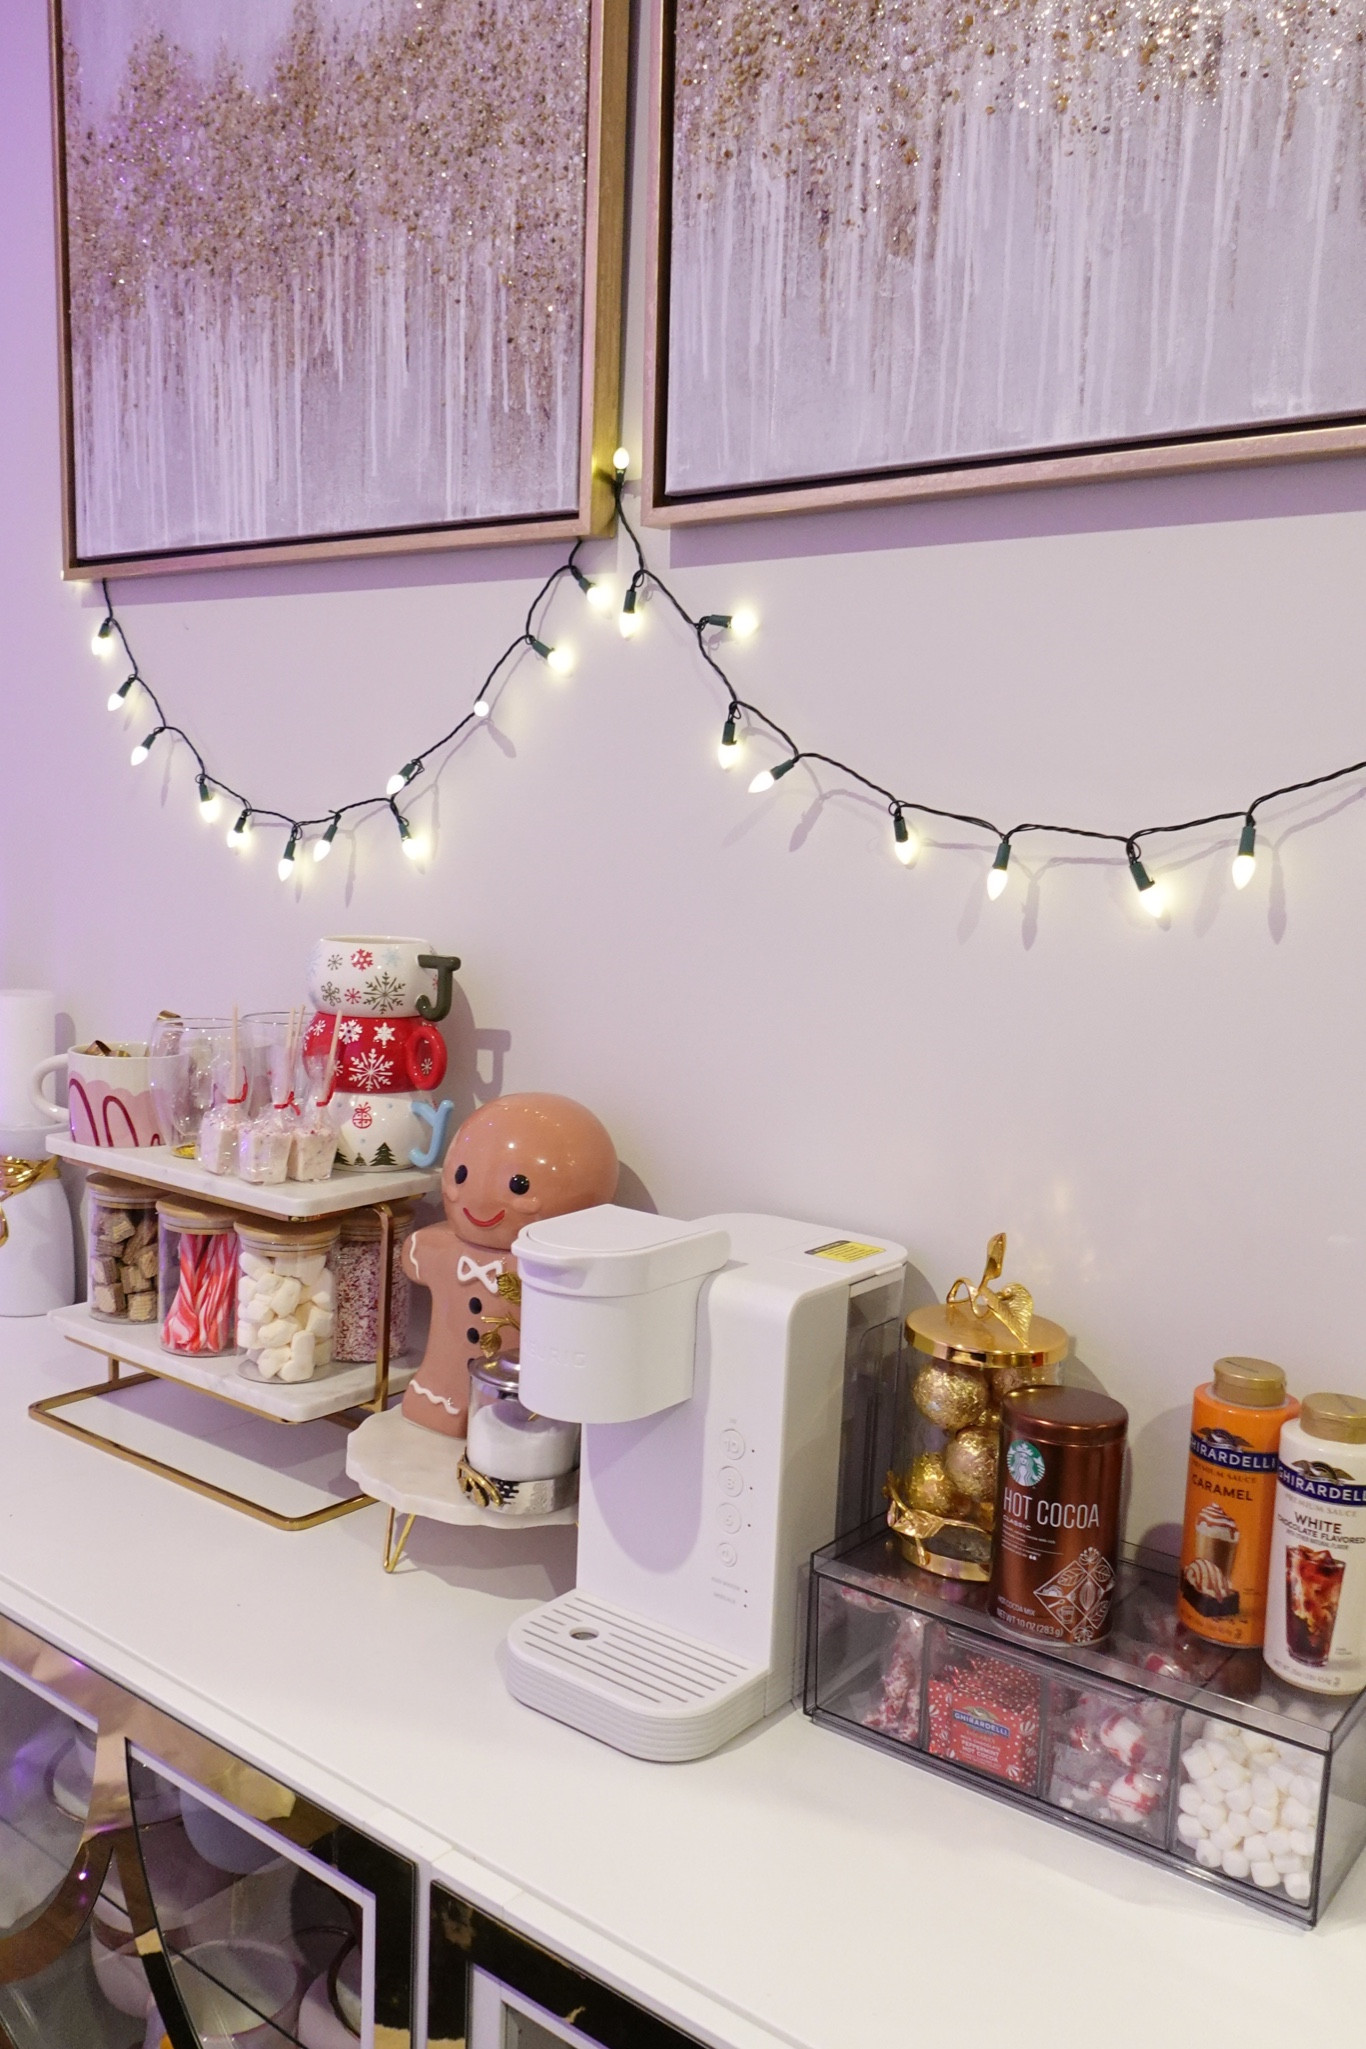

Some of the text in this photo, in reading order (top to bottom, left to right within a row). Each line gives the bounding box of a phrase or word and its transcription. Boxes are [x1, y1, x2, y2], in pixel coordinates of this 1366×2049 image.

[523, 1336, 588, 1368] EURIG
[1190, 1436, 1276, 1469] HIRARDELLI
[1191, 1473, 1254, 1501] CARAMEL
[1003, 1487, 1100, 1529] HOT COCOA
[1002, 1514, 1032, 1531] CLASSIC
[1294, 1511, 1342, 1534] WHITE
[1321, 1533, 1366, 1544] FLAVORED
[1036, 1624, 1054, 1635] (283
[954, 1712, 1008, 1735] GHIRARDELLI
